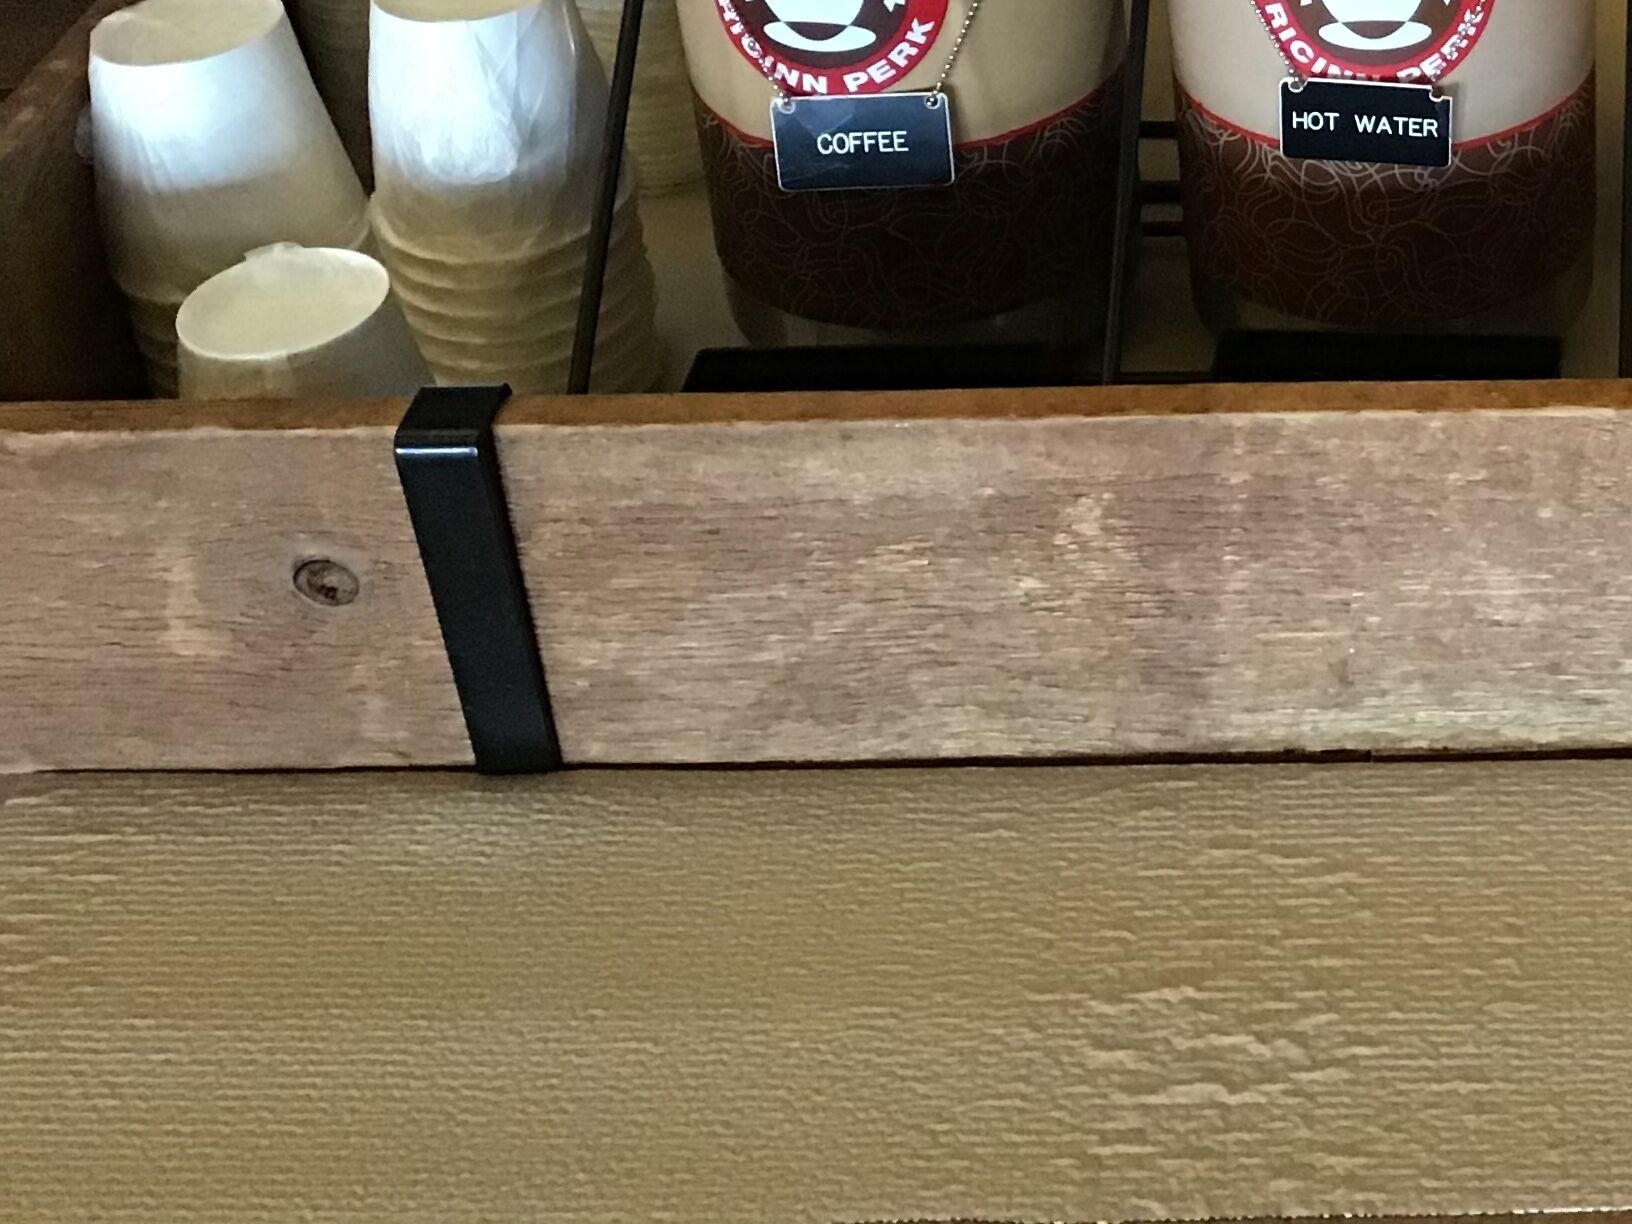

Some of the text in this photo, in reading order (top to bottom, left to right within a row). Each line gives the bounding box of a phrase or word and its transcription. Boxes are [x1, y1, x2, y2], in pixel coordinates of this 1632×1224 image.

[844, 17, 935, 93] PERK
[1292, 111, 1439, 138] HOT WATER
[816, 130, 909, 155] COFFEE
